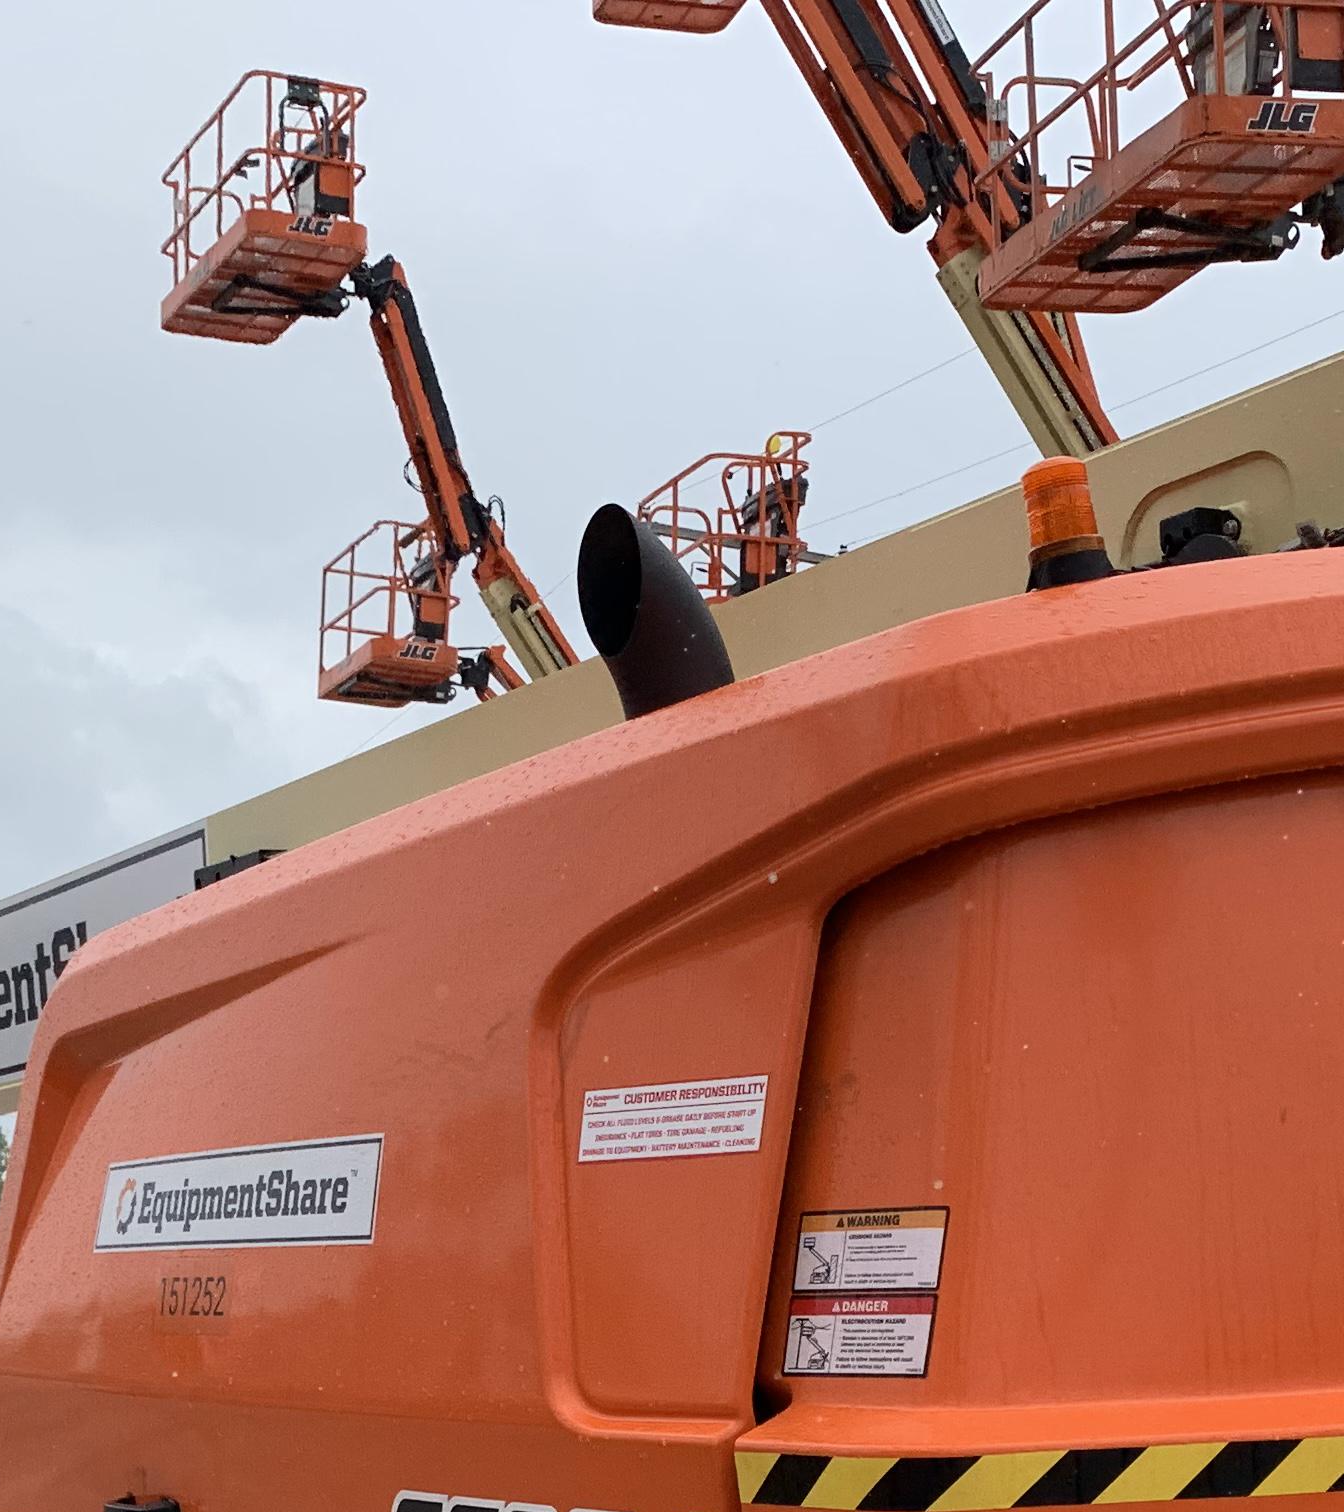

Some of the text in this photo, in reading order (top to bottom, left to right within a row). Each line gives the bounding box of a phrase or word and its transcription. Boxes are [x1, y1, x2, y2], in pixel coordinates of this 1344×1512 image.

[1248, 102, 1319, 133] JLG
[288, 216, 332, 236] JLG
[399, 642, 438, 660] JLG
[624, 1083, 765, 1105] CUSTOMER RESPONSIBILITY
[137, 1169, 349, 1233] EquipmentShare
[846, 1214, 900, 1228] WARNING
[159, 1276, 226, 1317] 151252
[842, 1300, 888, 1312] DANGER
